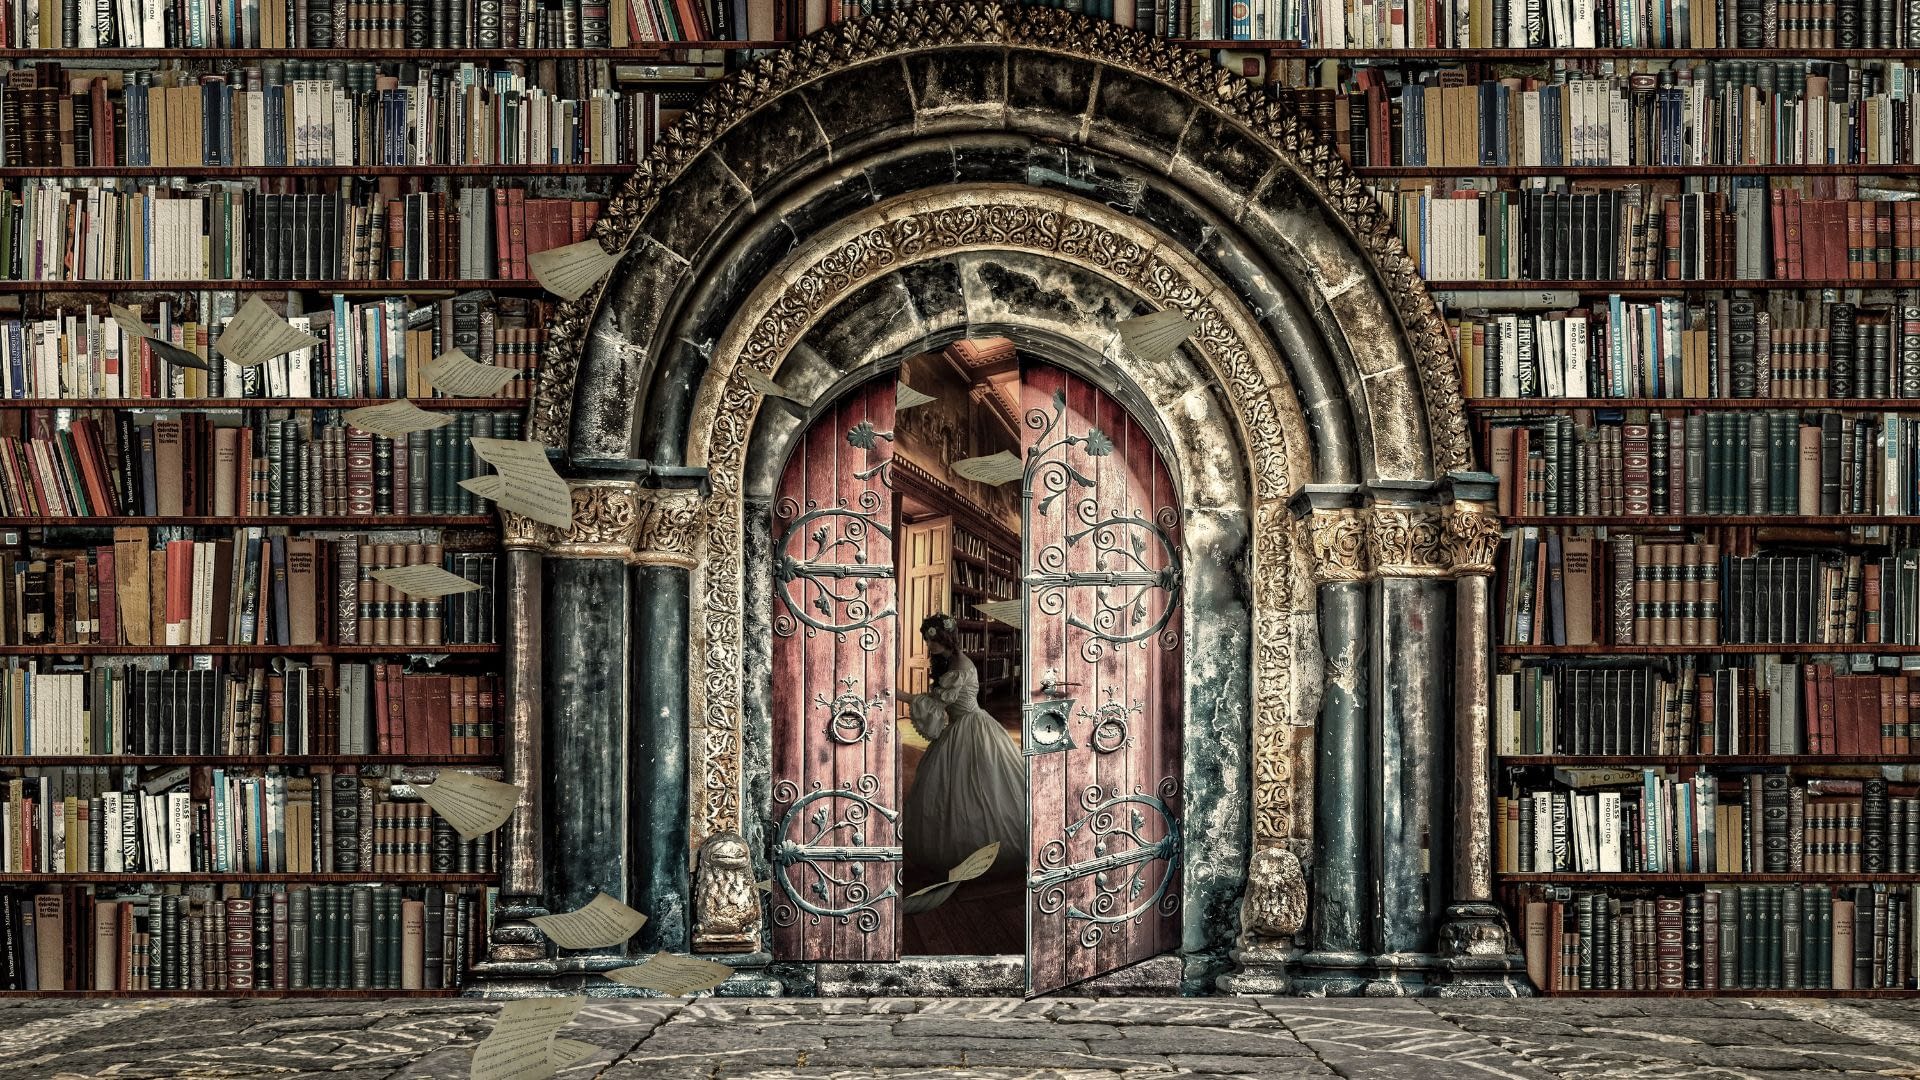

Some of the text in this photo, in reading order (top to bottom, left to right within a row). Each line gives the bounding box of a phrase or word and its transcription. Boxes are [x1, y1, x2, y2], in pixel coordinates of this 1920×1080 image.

[1518, 328, 1532, 380] FRENCH KISS
[122, 420, 130, 452] Mittelfranken
[124, 454, 132, 471] Bayern
[125, 477, 134, 503] Denkmäler
[246, 592, 254, 614] Pegnitz
[122, 802, 136, 856] FRENCH KISS
[1553, 803, 1566, 855] FRENCH KISS
[217, 834, 226, 865] LUXURY
[3, 895, 11, 926] Mittelfranken
[5, 929, 14, 945] Bayern
[7, 951, 15, 977] Denkmäler
